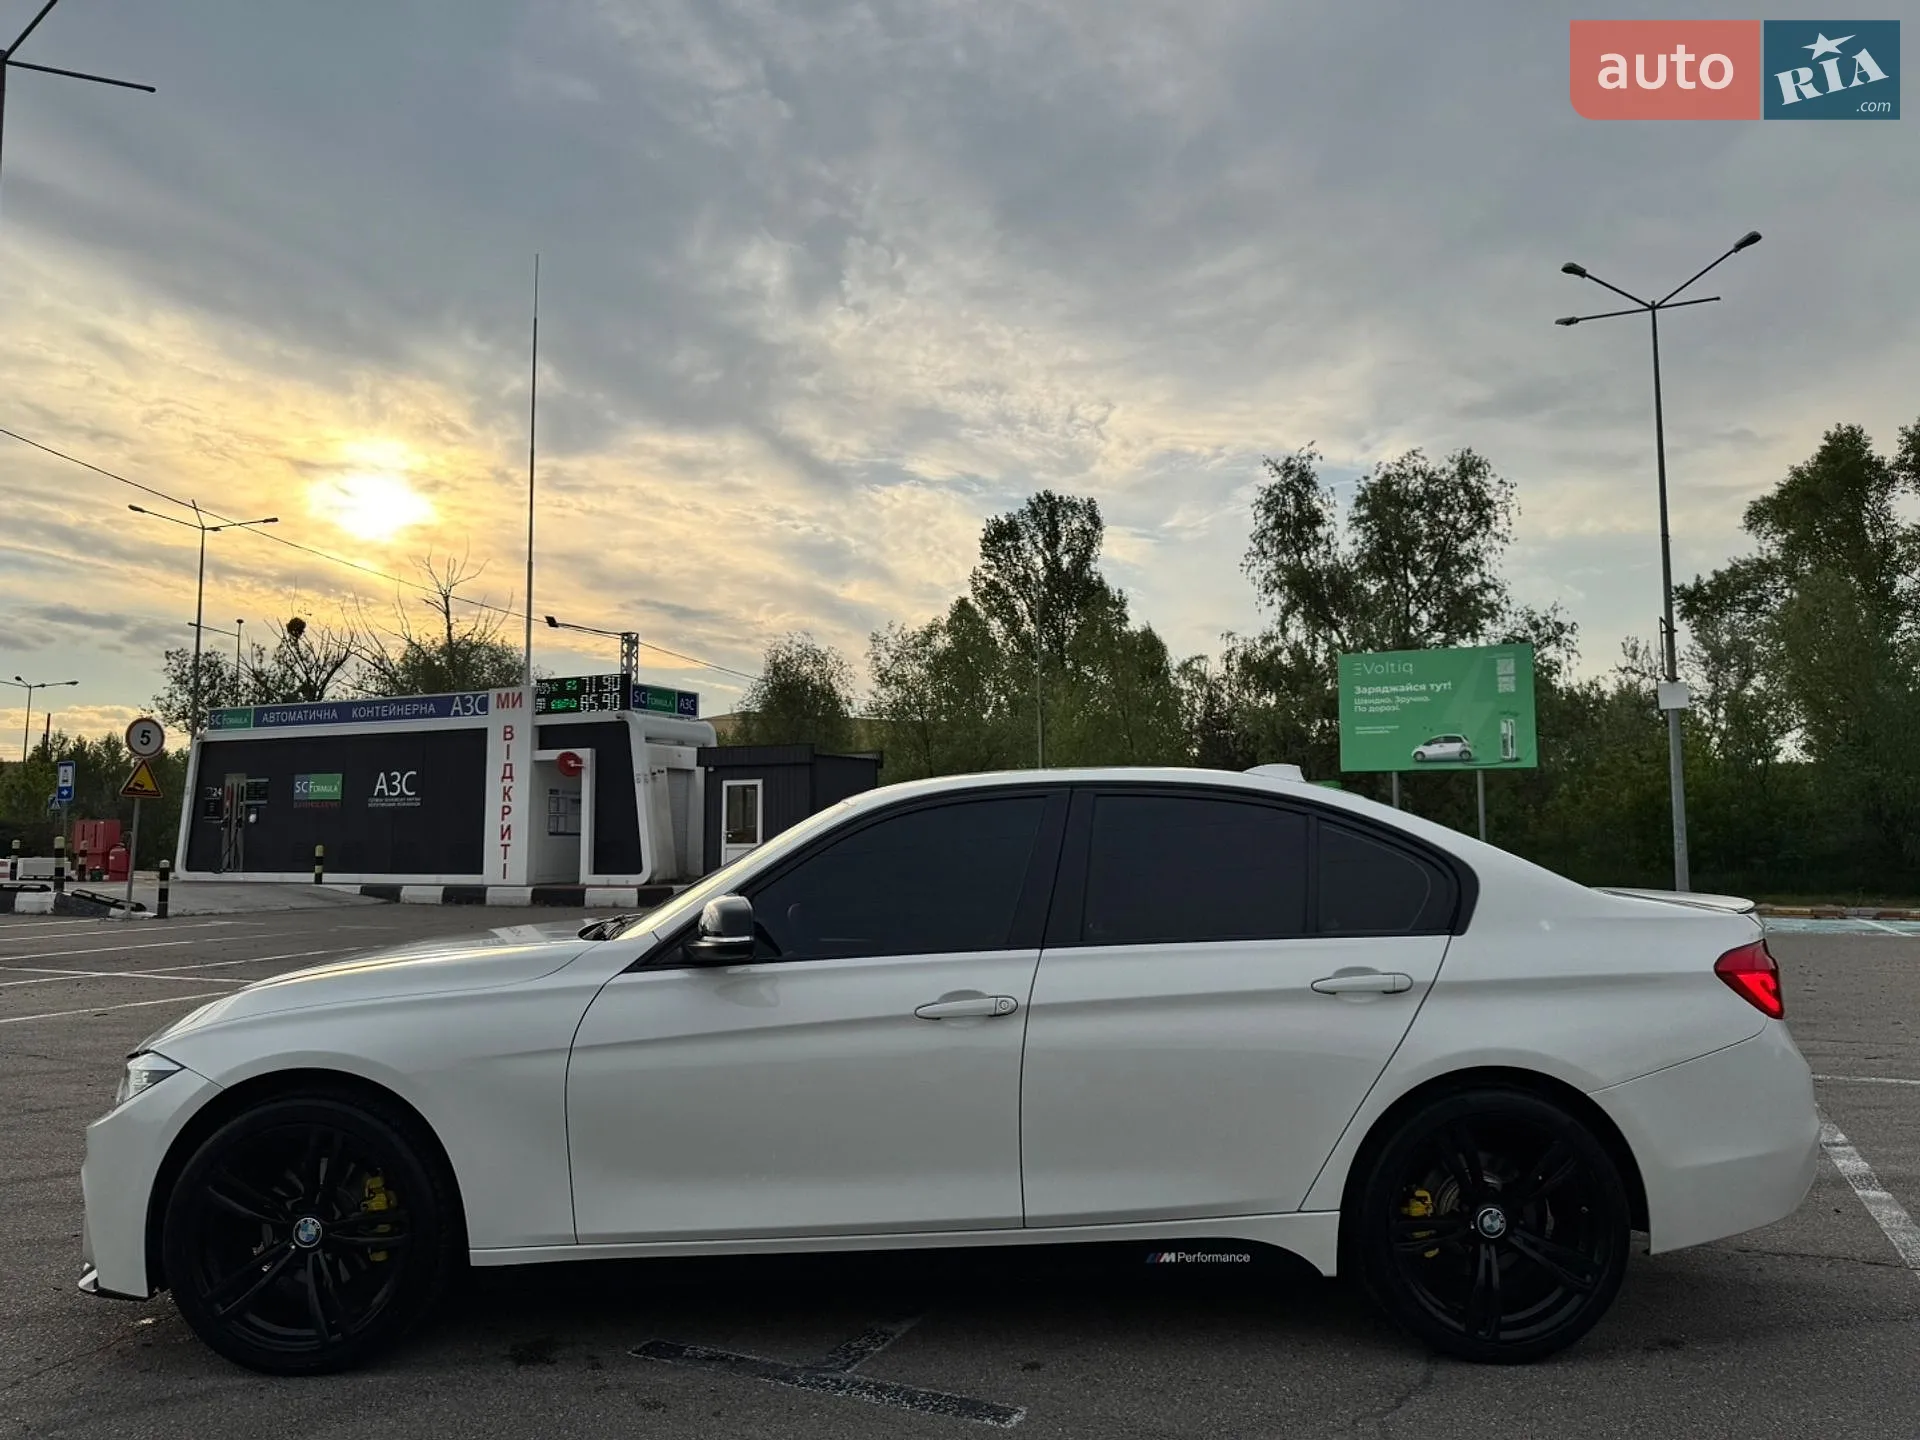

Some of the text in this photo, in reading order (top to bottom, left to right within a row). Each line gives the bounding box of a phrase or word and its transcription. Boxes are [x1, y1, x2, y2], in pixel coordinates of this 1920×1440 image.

[262, 694, 488, 723] АВТОМАТИЧНА КОНТЕЙНЕРНА АЗС
[495, 691, 523, 709] МИ
[140, 729, 151, 746] 5
[373, 770, 418, 797] АЗС
[1177, 1251, 1251, 1264] Performance
